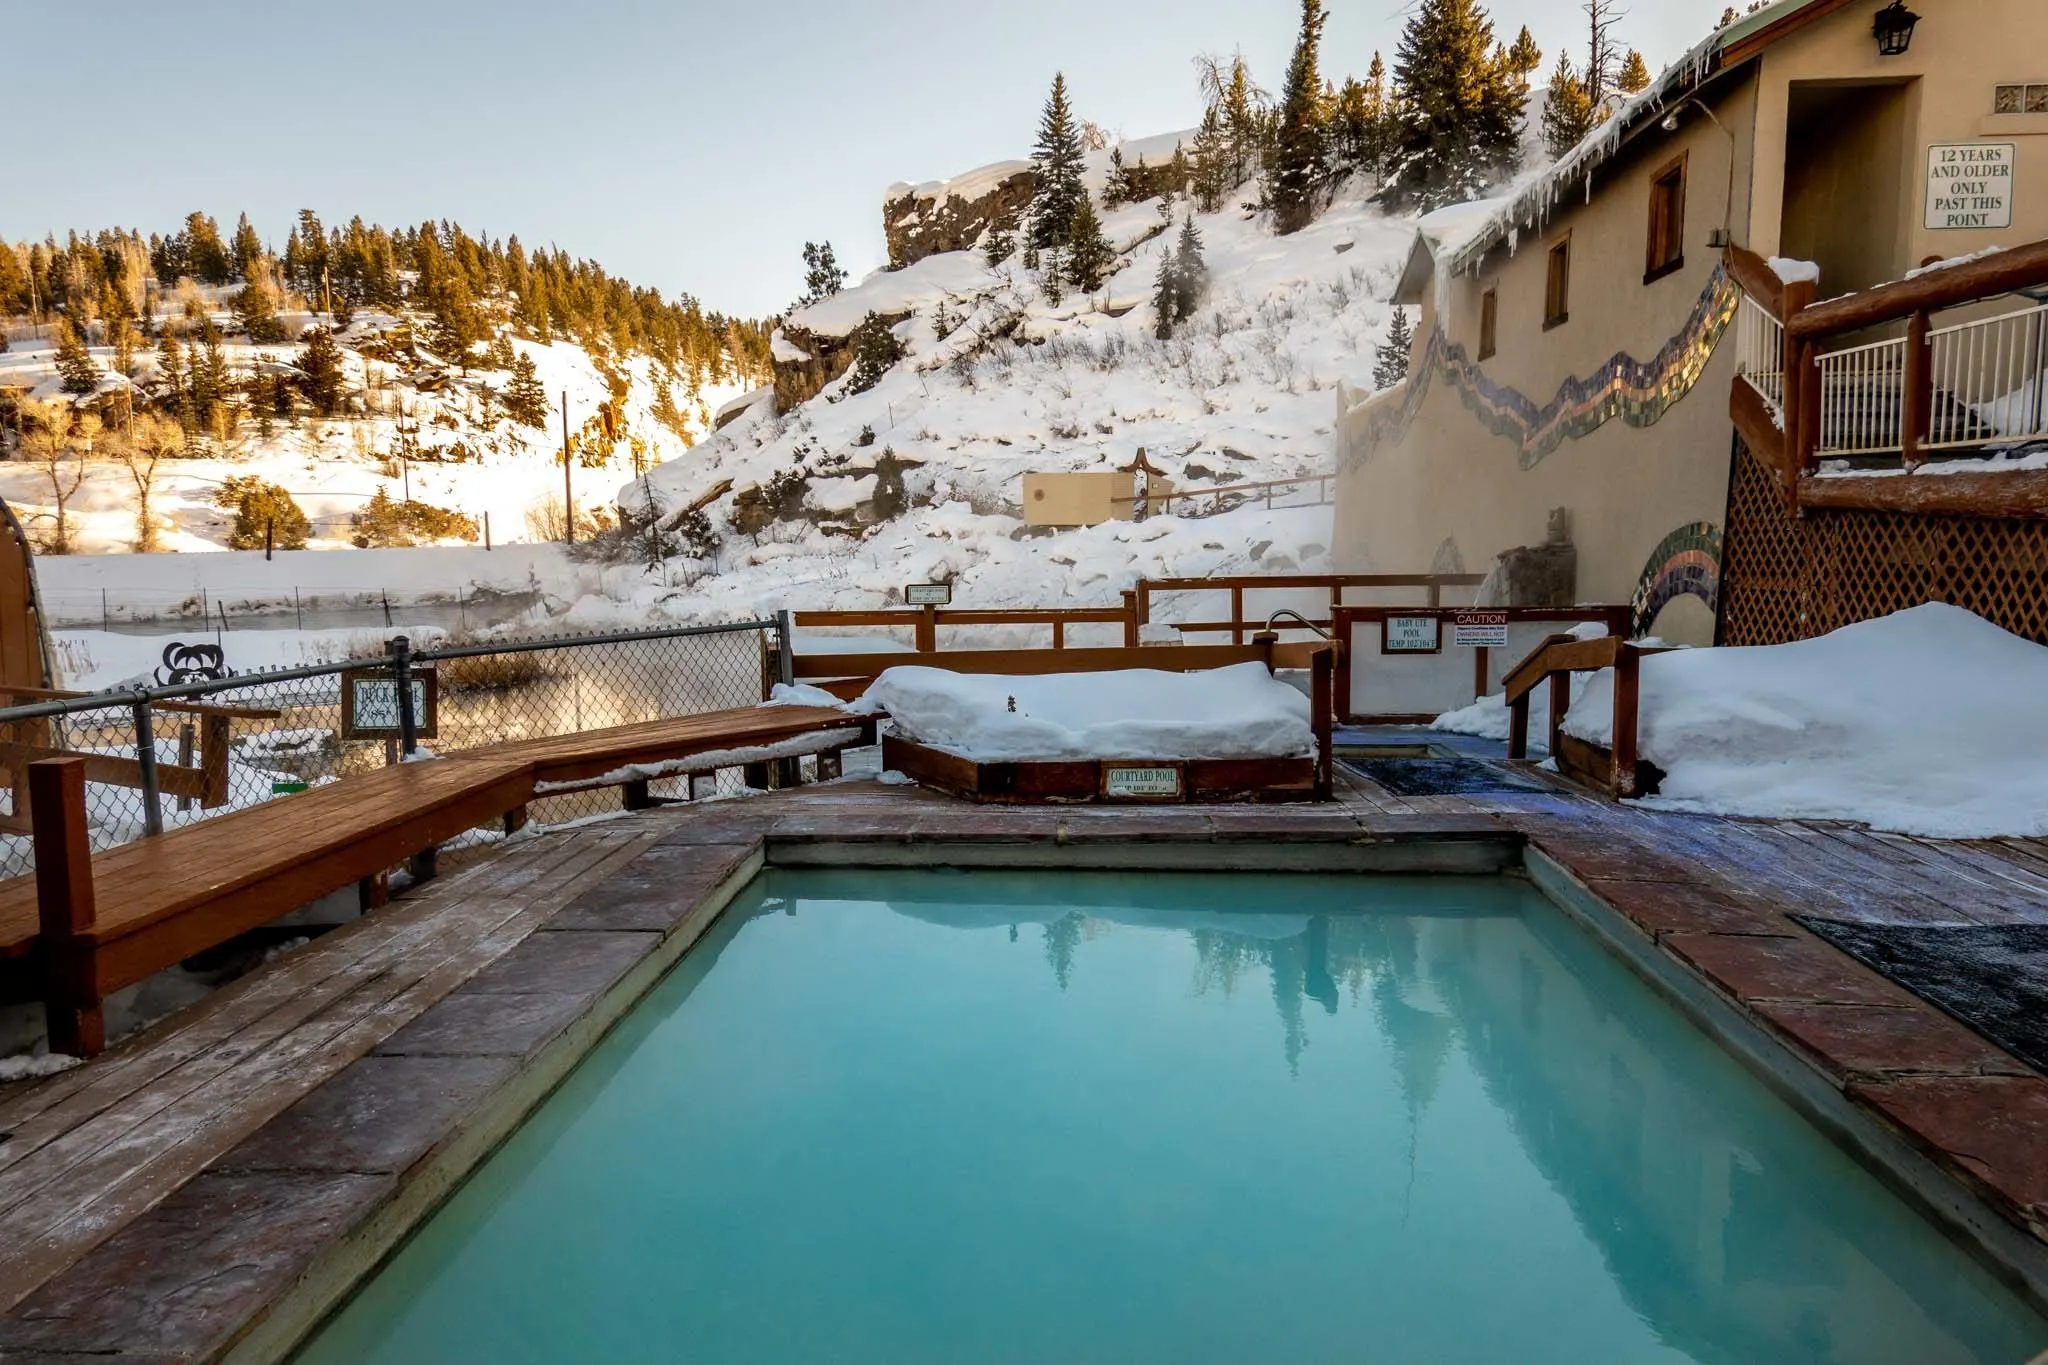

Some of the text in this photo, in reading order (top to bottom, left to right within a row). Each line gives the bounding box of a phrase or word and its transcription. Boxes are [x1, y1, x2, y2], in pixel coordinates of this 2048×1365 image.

[1941, 149, 2002, 162] 12 YEARS
[1931, 165, 2009, 178] AND OLDER
[1950, 182, 1988, 194] ONLY
[1935, 197, 2002, 210] PAST THIS
[1946, 213, 1989, 226] POINT
[1457, 614, 1506, 624] CAUTION
[1403, 629, 1421, 638] POOL
[1389, 640, 1406, 648] TEMP
[361, 686, 389, 703] DUCK
[1111, 770, 1174, 781] COURTYARD POOL
